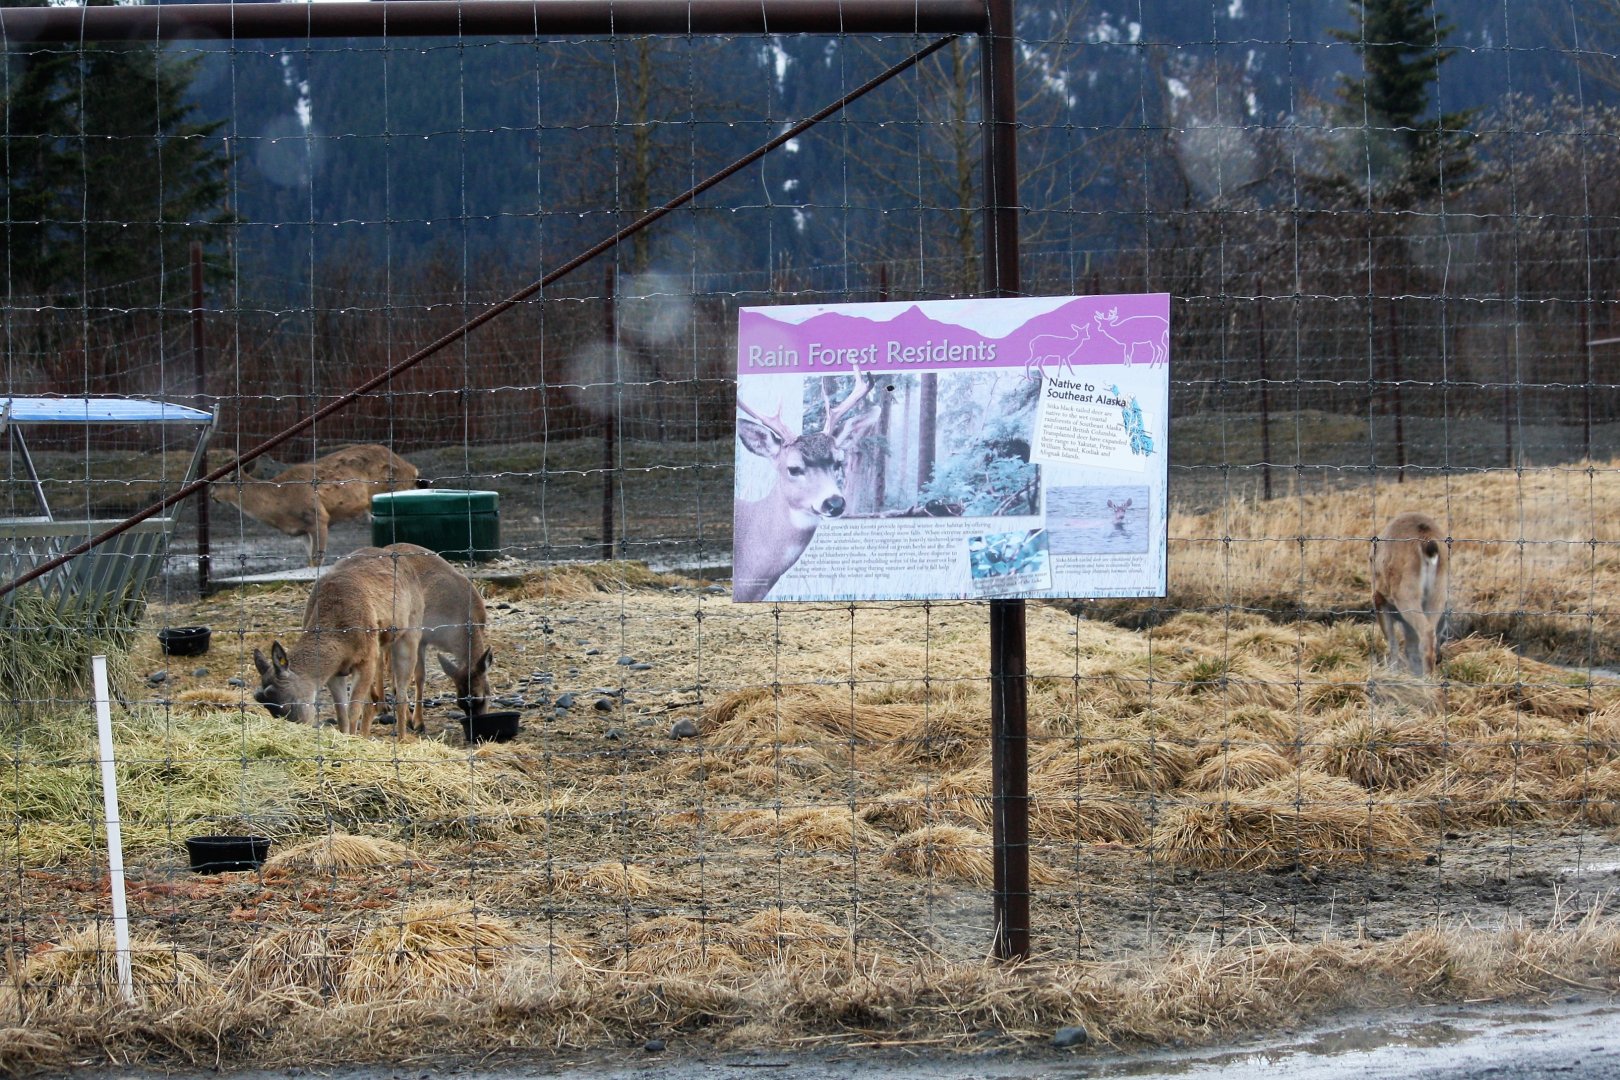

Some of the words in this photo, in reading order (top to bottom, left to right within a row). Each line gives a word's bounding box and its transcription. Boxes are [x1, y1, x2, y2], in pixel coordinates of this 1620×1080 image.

[749, 344, 799, 367] Rain
[808, 342, 878, 366] Forest
[887, 339, 997, 363] Residents
[1049, 378, 1082, 391] Native
[1084, 383, 1095, 392] to
[1047, 389, 1093, 403] Southeast
[1095, 395, 1126, 408] Alaska
[1072, 426, 1090, 434] British
[1079, 421, 1104, 429] Southeast
[1081, 447, 1100, 455] Kodiak
